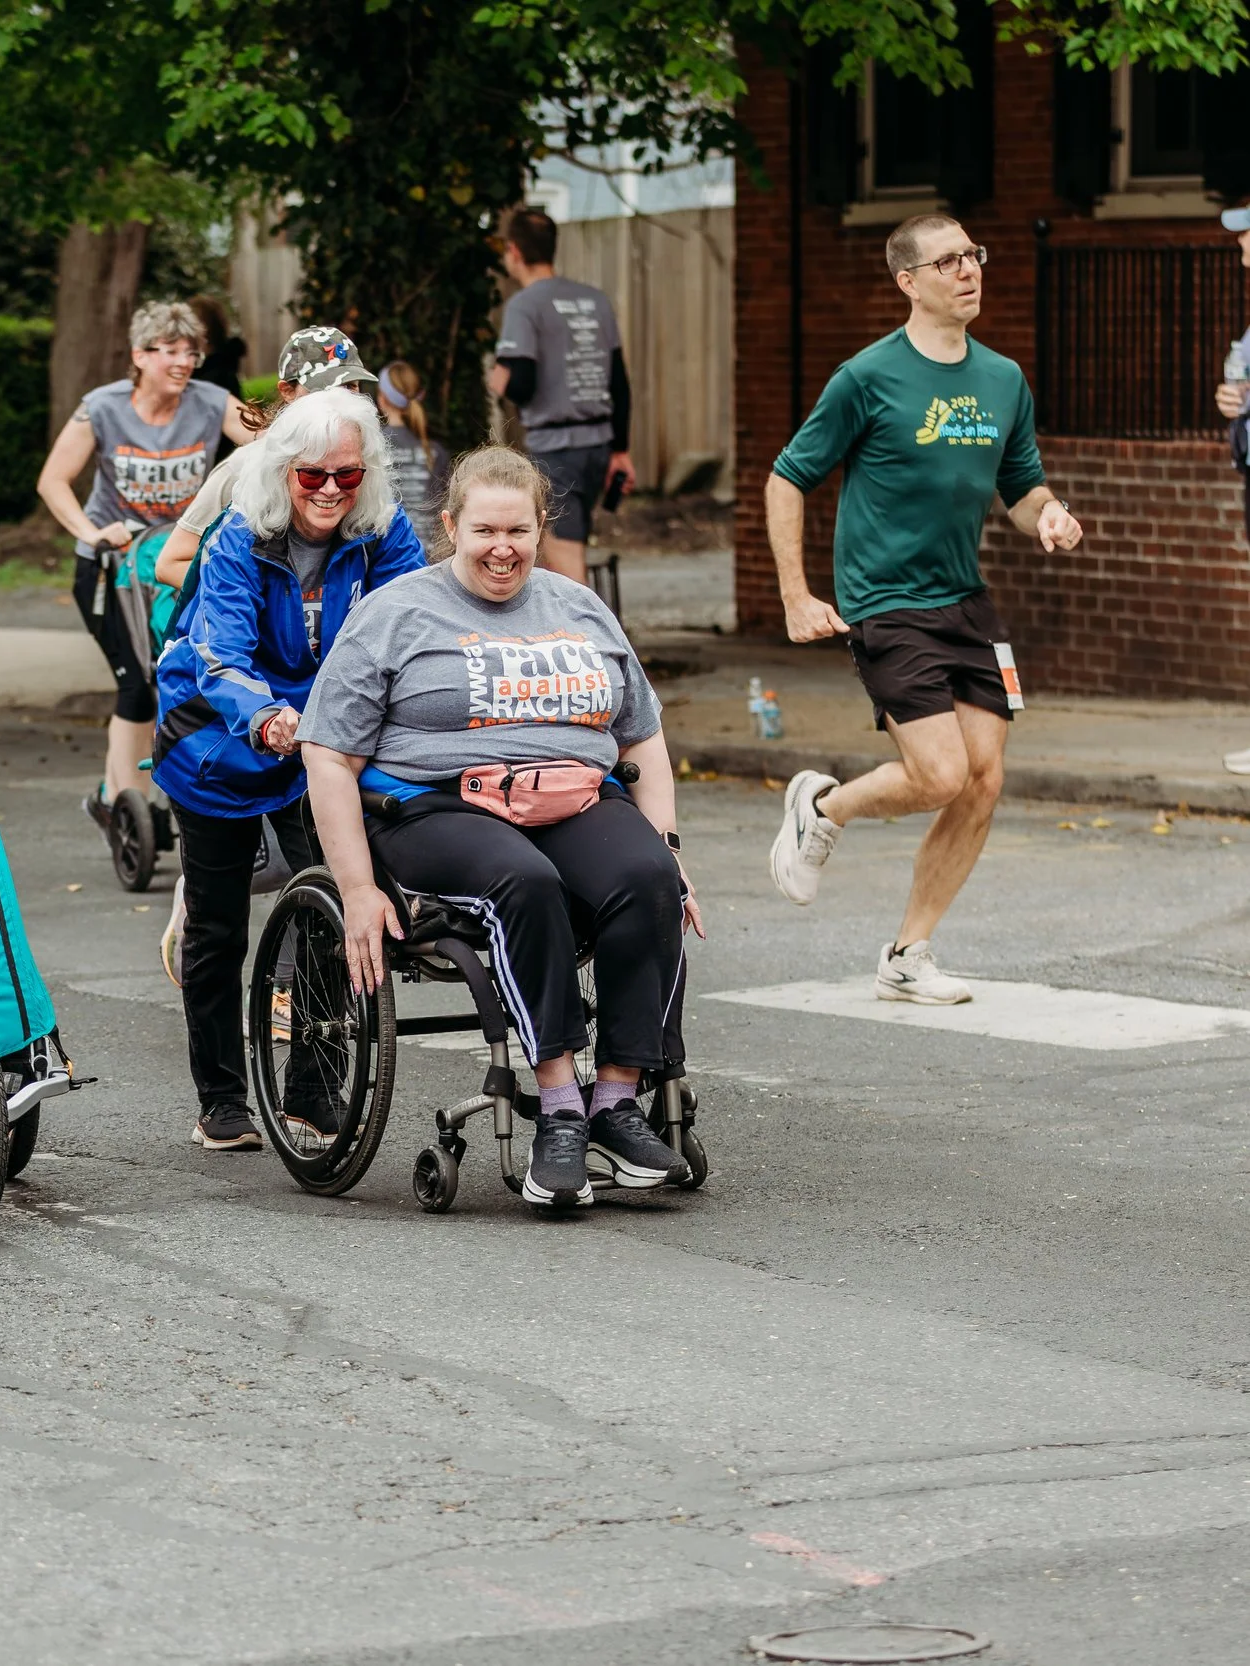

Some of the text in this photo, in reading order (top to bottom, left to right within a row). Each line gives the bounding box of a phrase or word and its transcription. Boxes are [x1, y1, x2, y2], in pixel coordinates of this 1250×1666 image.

[323, 344, 347, 361] 76
[488, 644, 604, 678] race
[498, 671, 608, 701] against
[492, 689, 613, 718] RACISM
